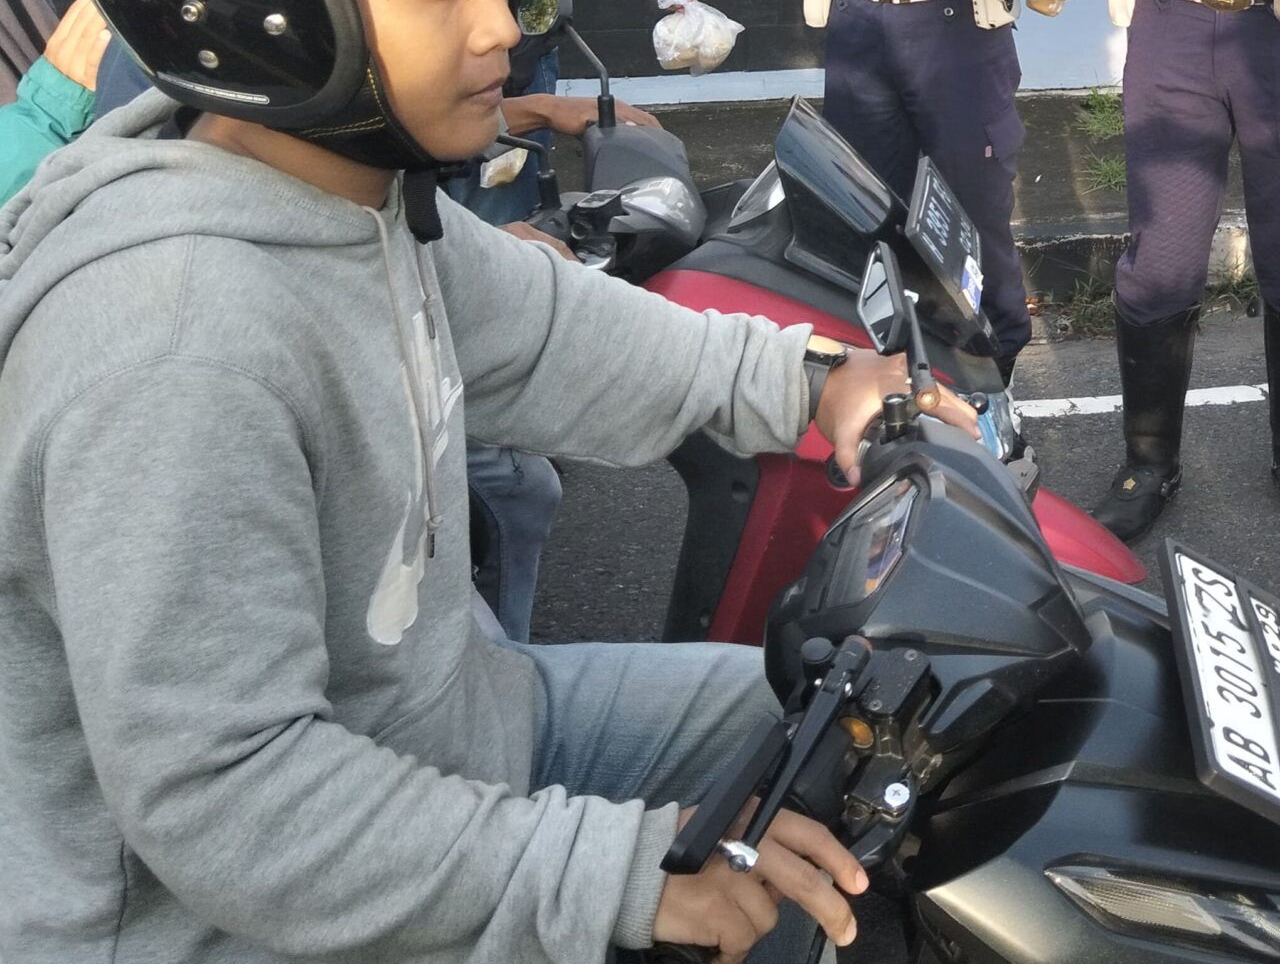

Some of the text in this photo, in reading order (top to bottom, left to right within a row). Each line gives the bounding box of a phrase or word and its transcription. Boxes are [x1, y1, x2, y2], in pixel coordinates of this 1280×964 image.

[1191, 567, 1277, 791] AB 3015 ZS
